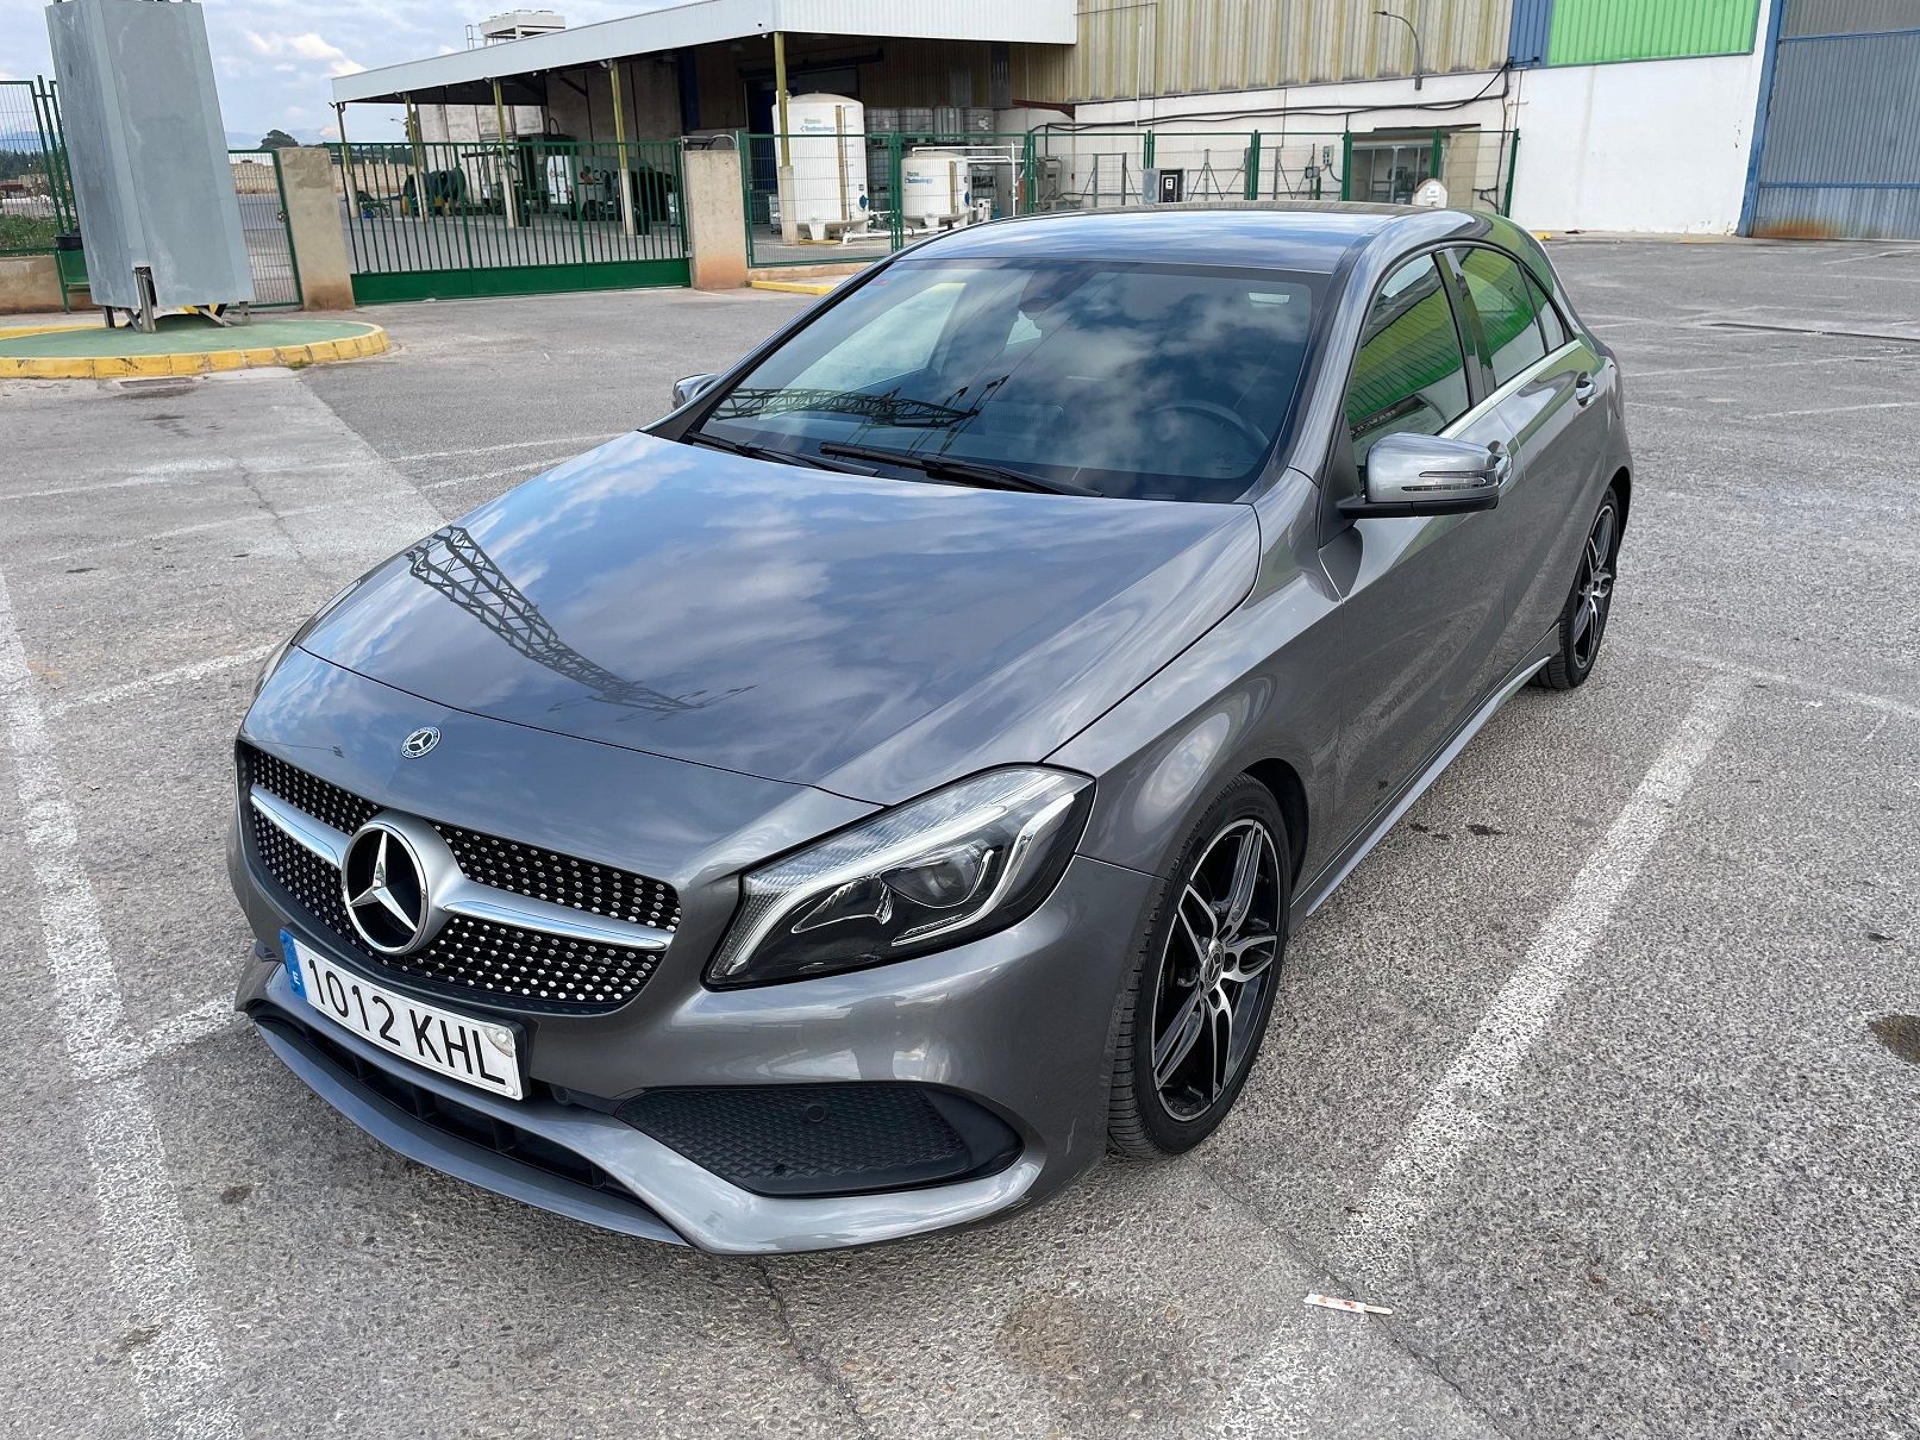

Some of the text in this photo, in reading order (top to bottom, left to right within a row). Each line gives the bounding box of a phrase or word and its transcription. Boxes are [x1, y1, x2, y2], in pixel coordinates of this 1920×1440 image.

[292, 970, 301, 986] E
[308, 958, 506, 1086] 1012 KHL
